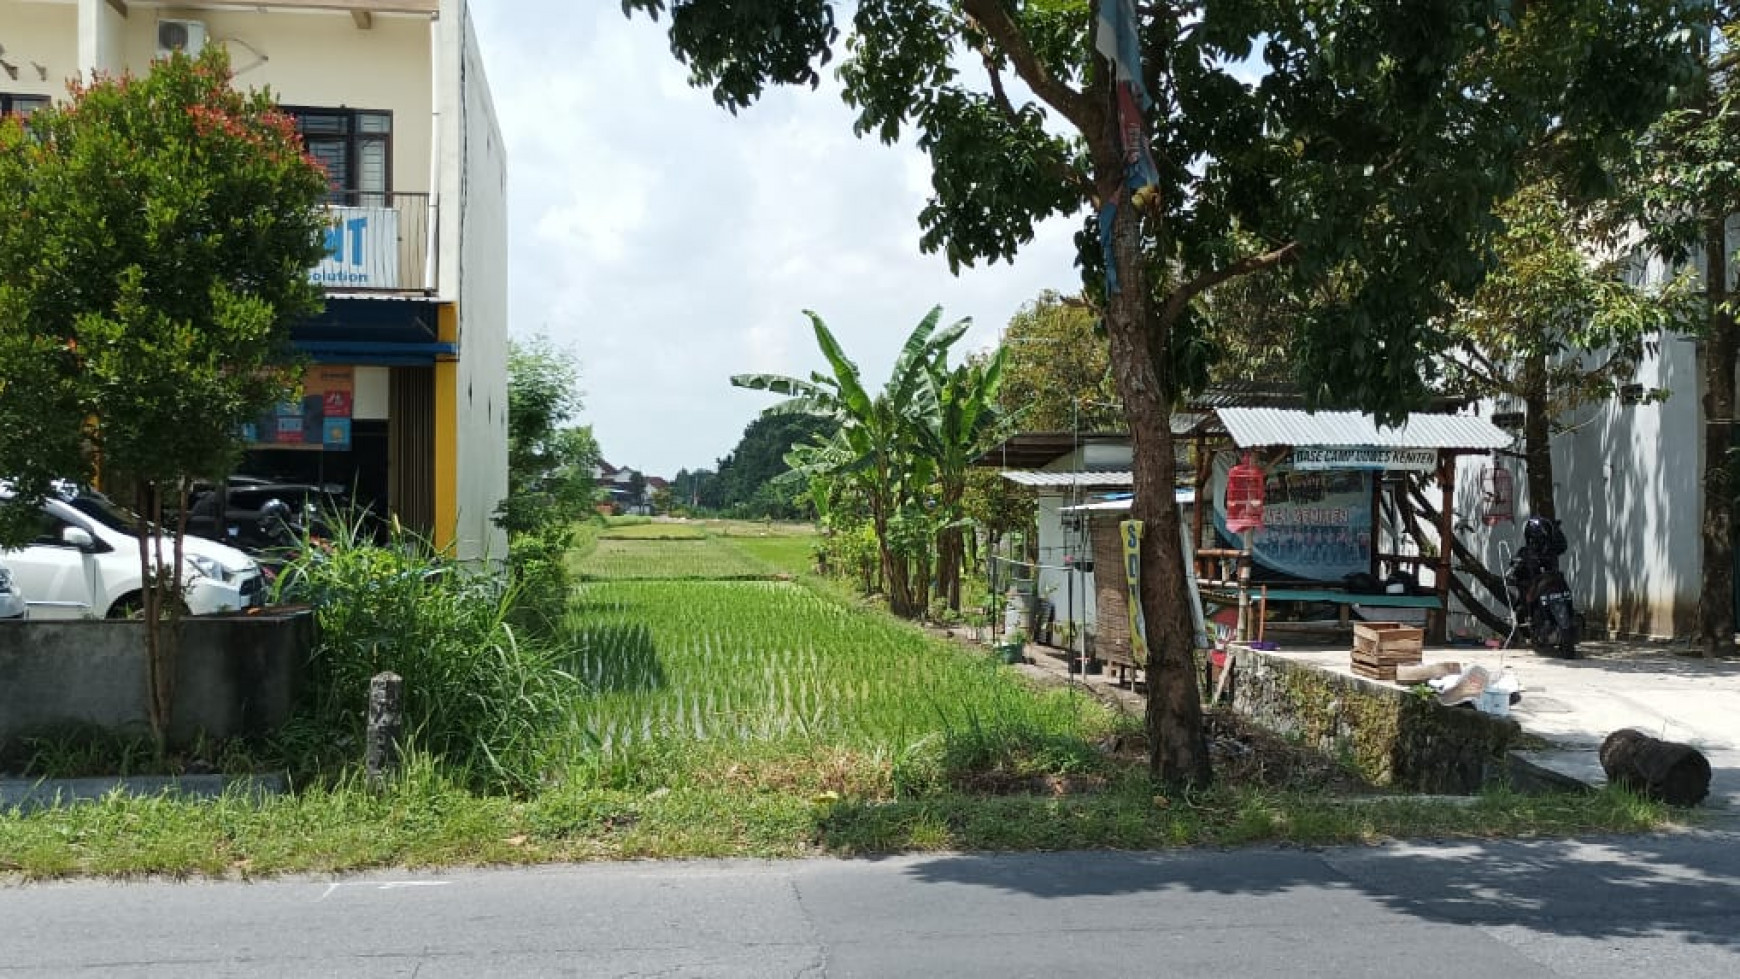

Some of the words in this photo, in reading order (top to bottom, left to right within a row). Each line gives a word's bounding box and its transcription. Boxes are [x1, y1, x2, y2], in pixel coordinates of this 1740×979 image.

[309, 270, 368, 282] olution
[1296, 450, 1323, 463] BASE
[1324, 450, 1355, 463] CAMP
[1392, 450, 1435, 465] KENITEN
